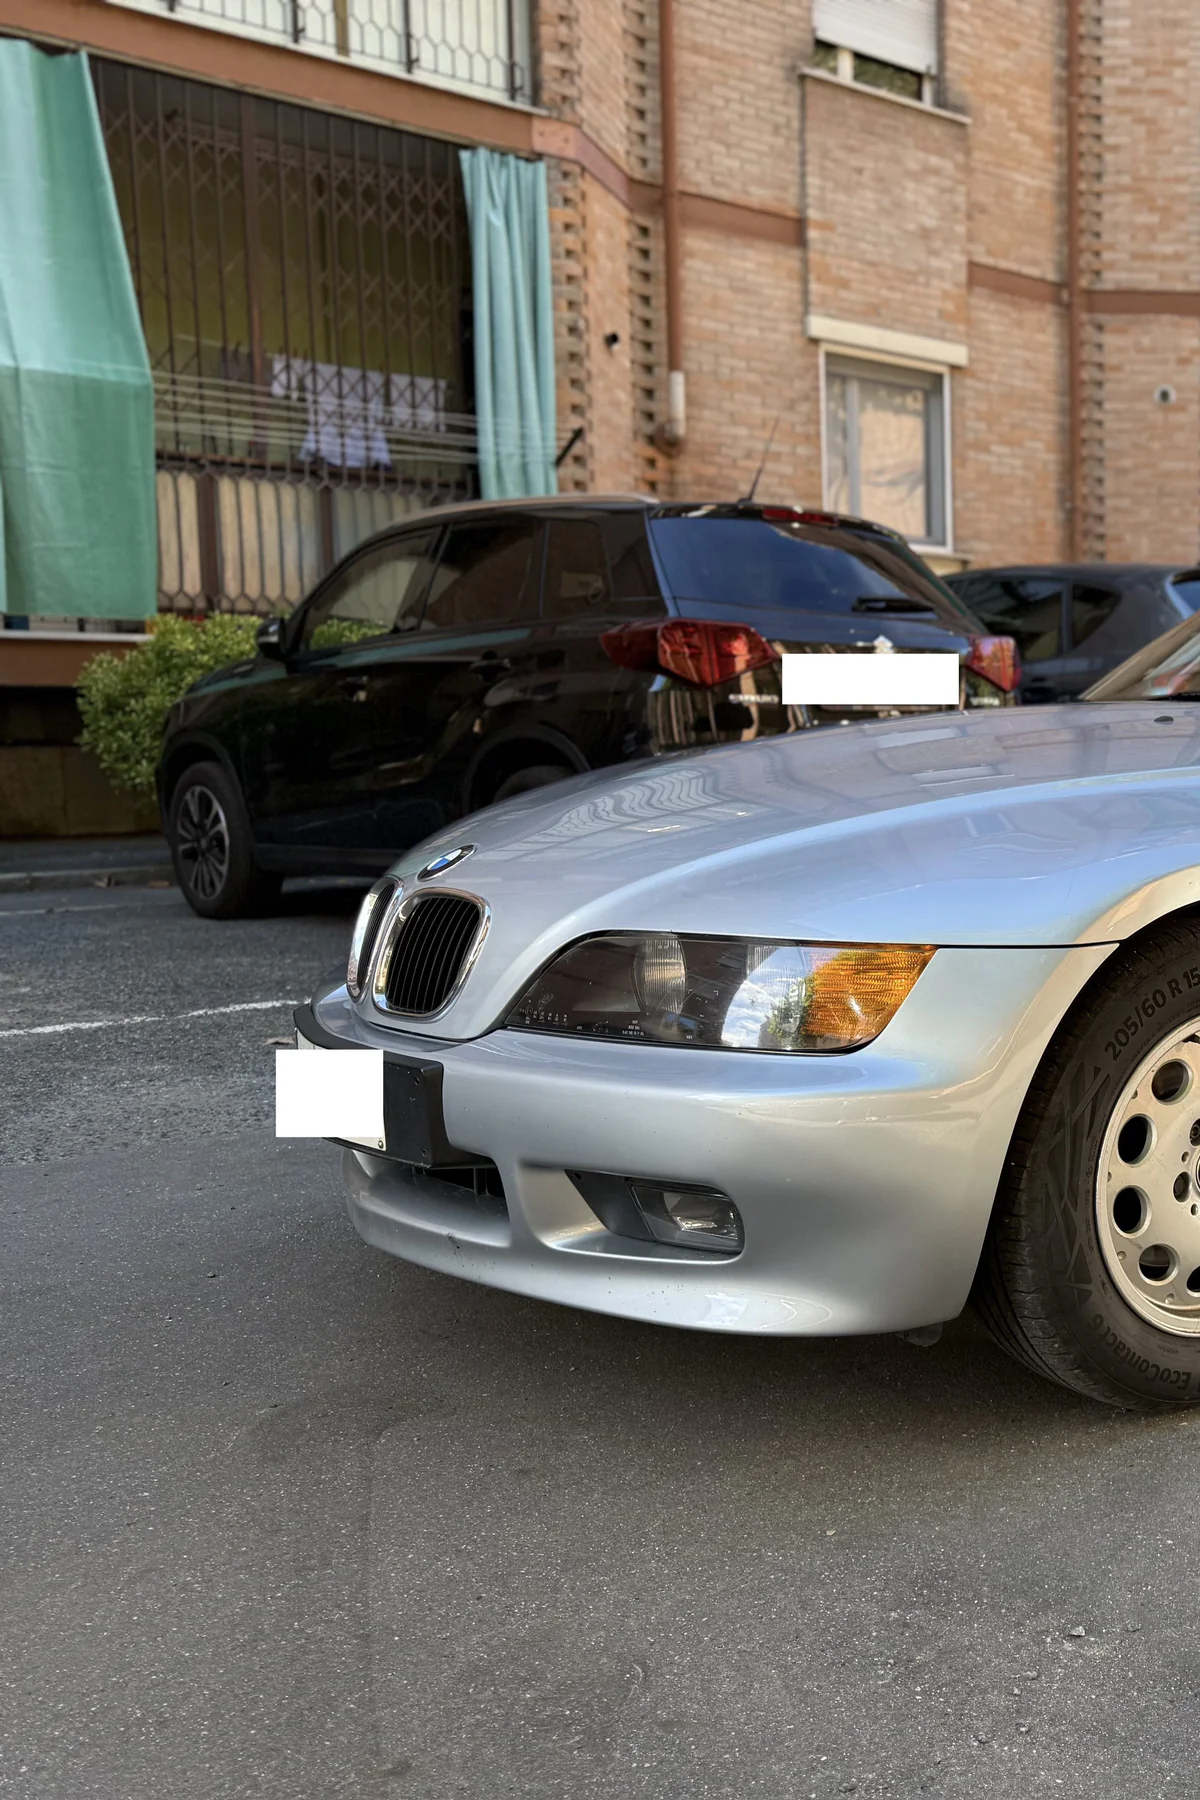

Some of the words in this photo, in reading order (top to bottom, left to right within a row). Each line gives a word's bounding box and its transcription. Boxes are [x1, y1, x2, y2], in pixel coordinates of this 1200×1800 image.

[1105, 988, 1167, 1061] 205/60
[1167, 978, 1183, 999] R
[1099, 1325, 1192, 1391] EcoContact
